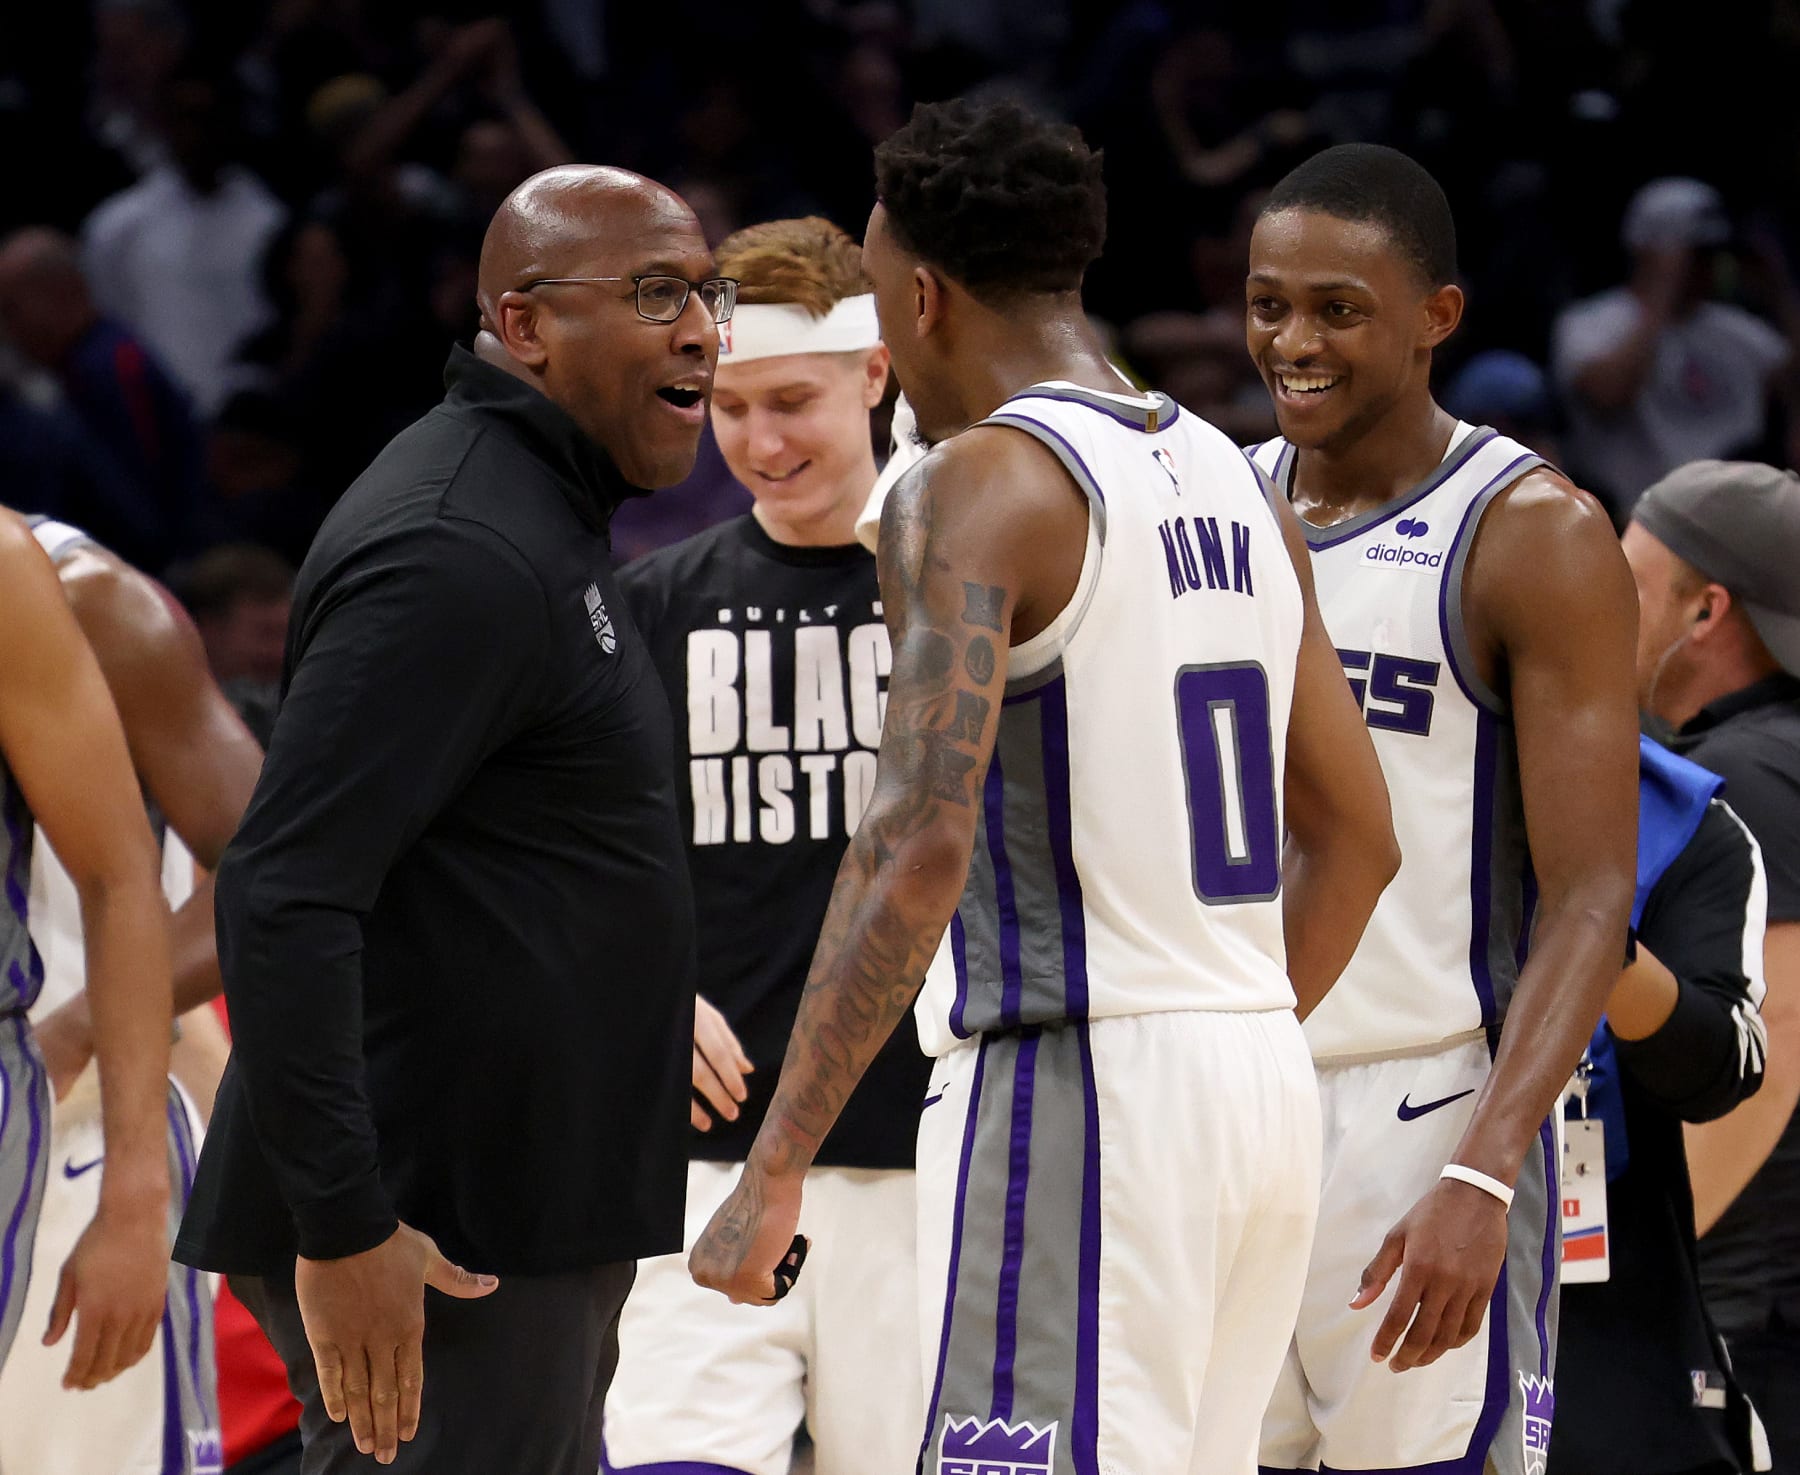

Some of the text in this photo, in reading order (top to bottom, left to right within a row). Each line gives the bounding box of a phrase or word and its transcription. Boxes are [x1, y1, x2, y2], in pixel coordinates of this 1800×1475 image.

[1158, 516, 1254, 600] MONK
[1366, 543, 1443, 566] dialpad
[718, 604, 838, 624] BUILT
[1174, 659, 1282, 906] 0
